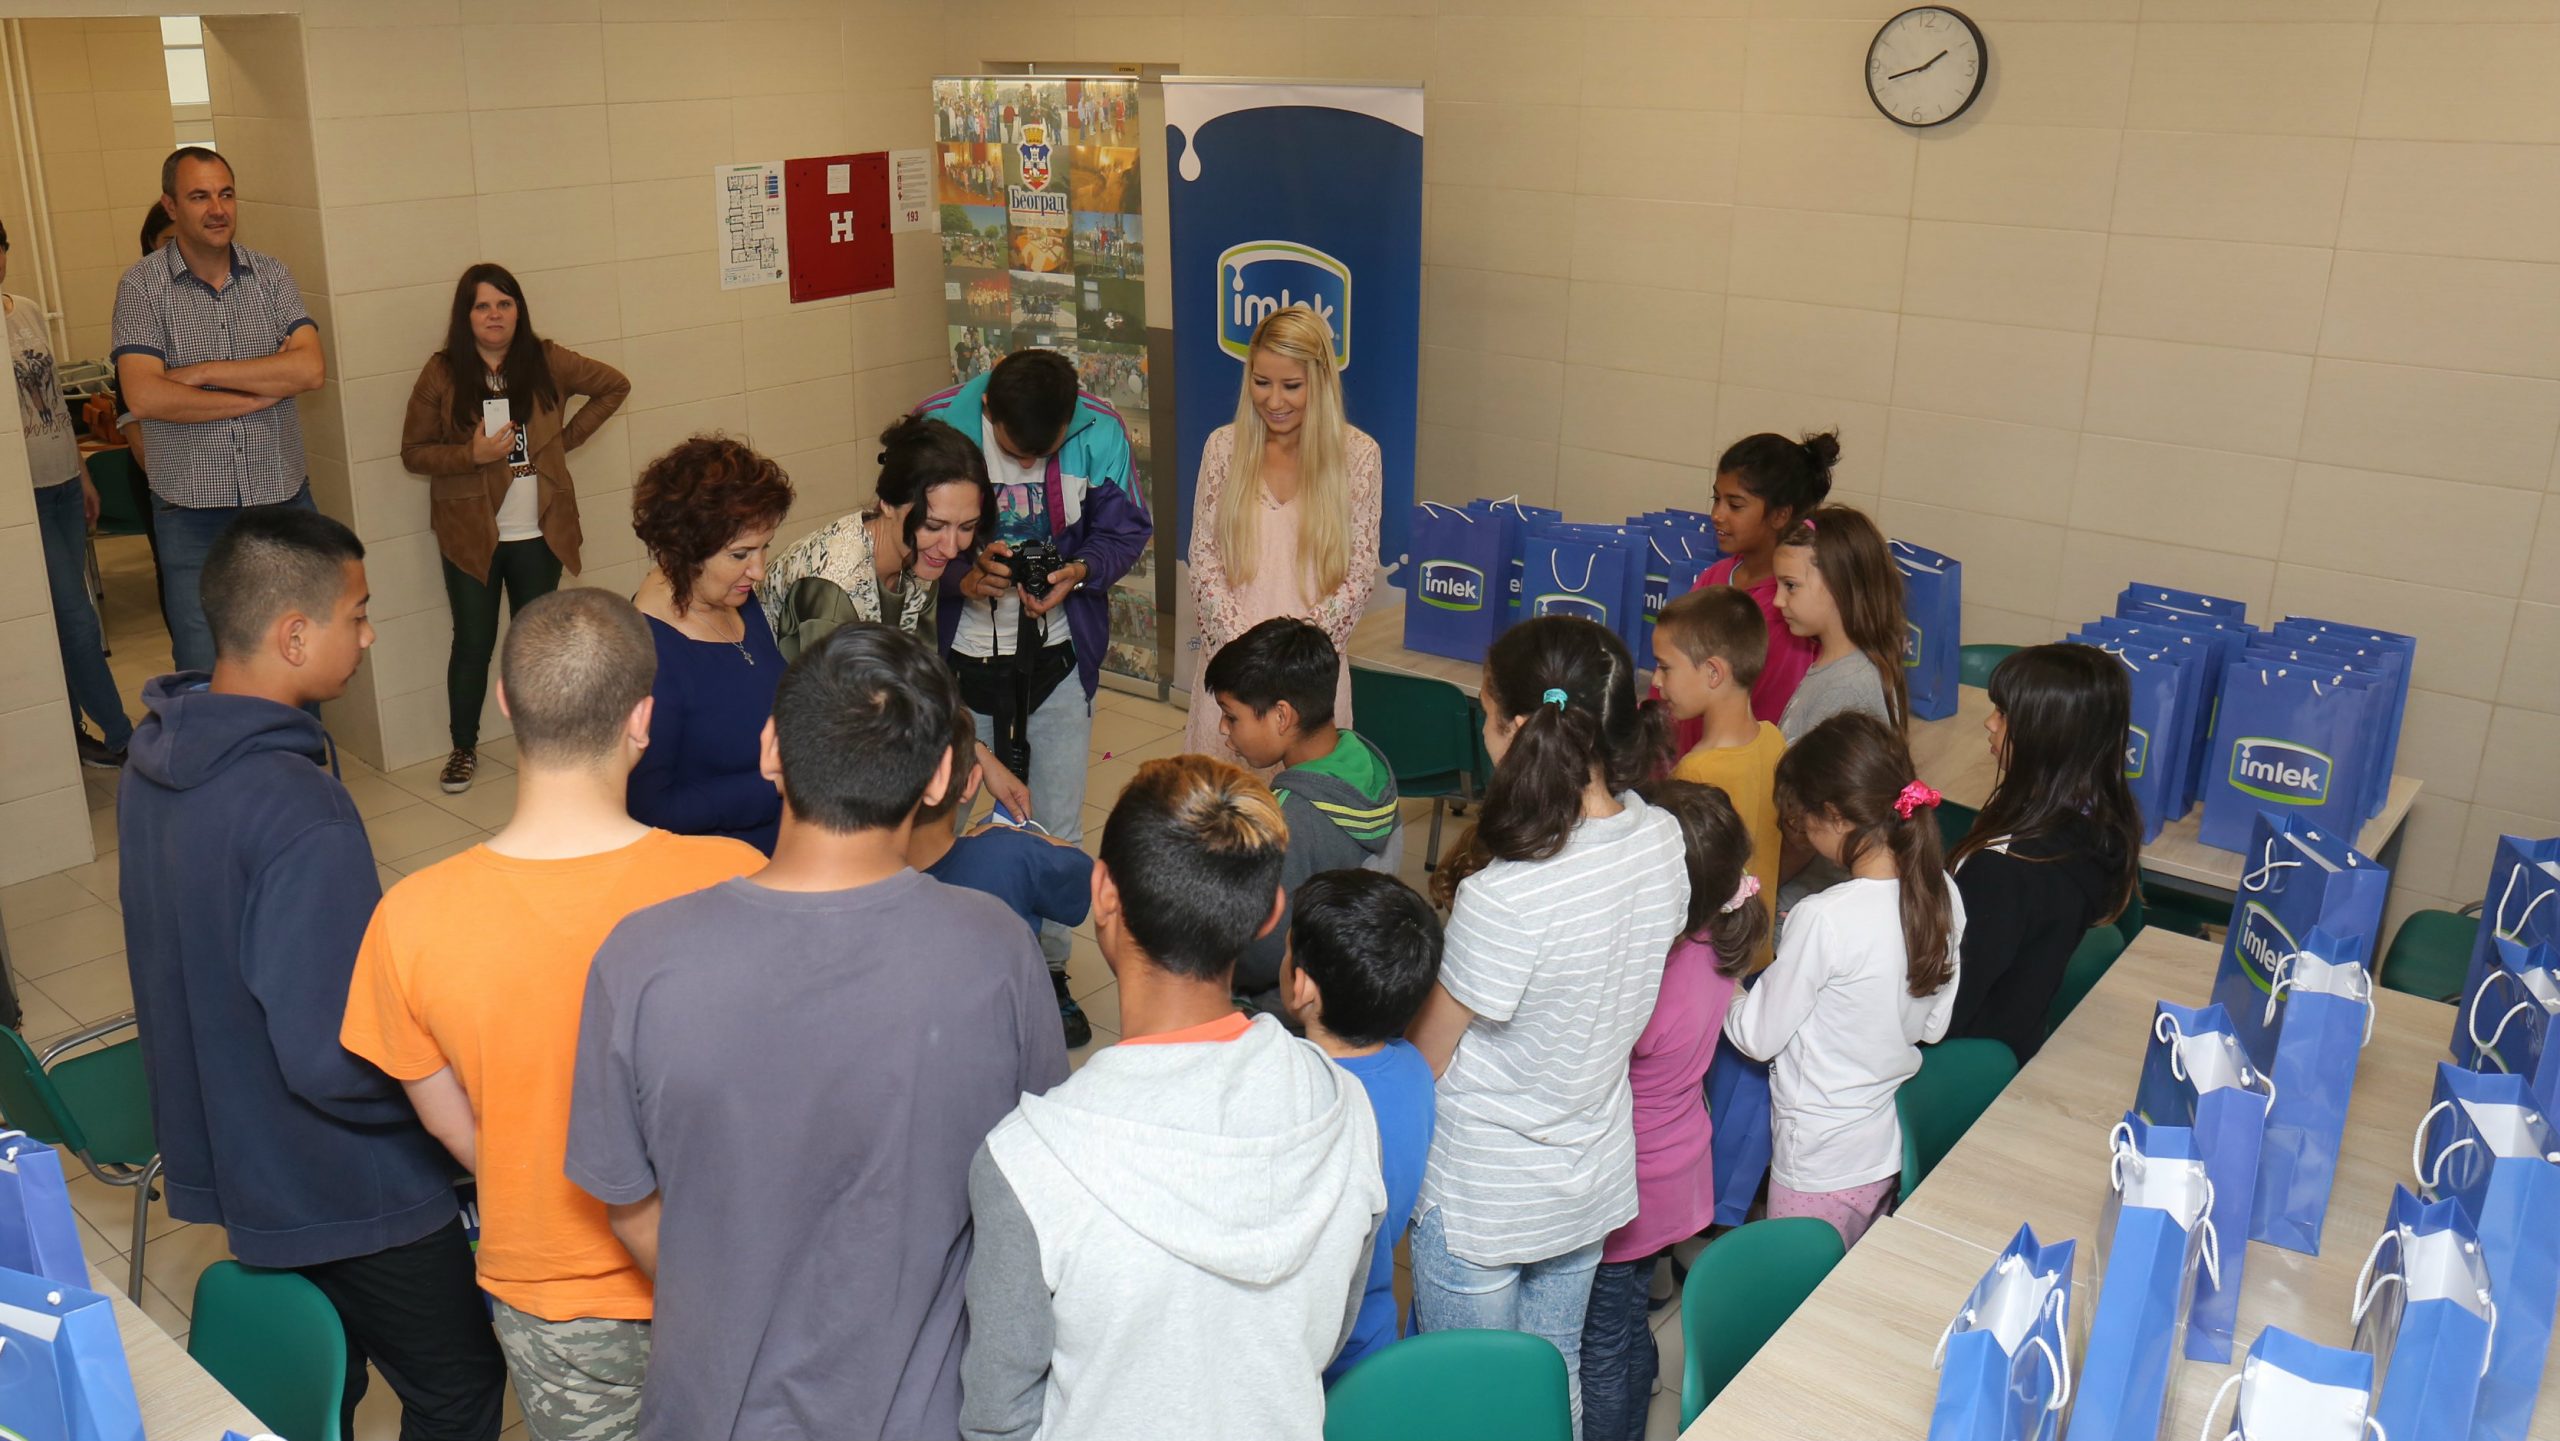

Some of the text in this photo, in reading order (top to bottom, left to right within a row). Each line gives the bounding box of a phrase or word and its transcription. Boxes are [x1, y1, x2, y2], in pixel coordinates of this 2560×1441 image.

[1918, 11, 1937, 29] 12
[1965, 59, 1977, 77] 3
[1911, 106, 1922, 122] 6
[1010, 188, 1065, 216] Београд
[906, 210, 919, 222] 193
[829, 210, 854, 244] H
[1425, 574, 1476, 599] imlek
[2240, 753, 2319, 791] imlek
